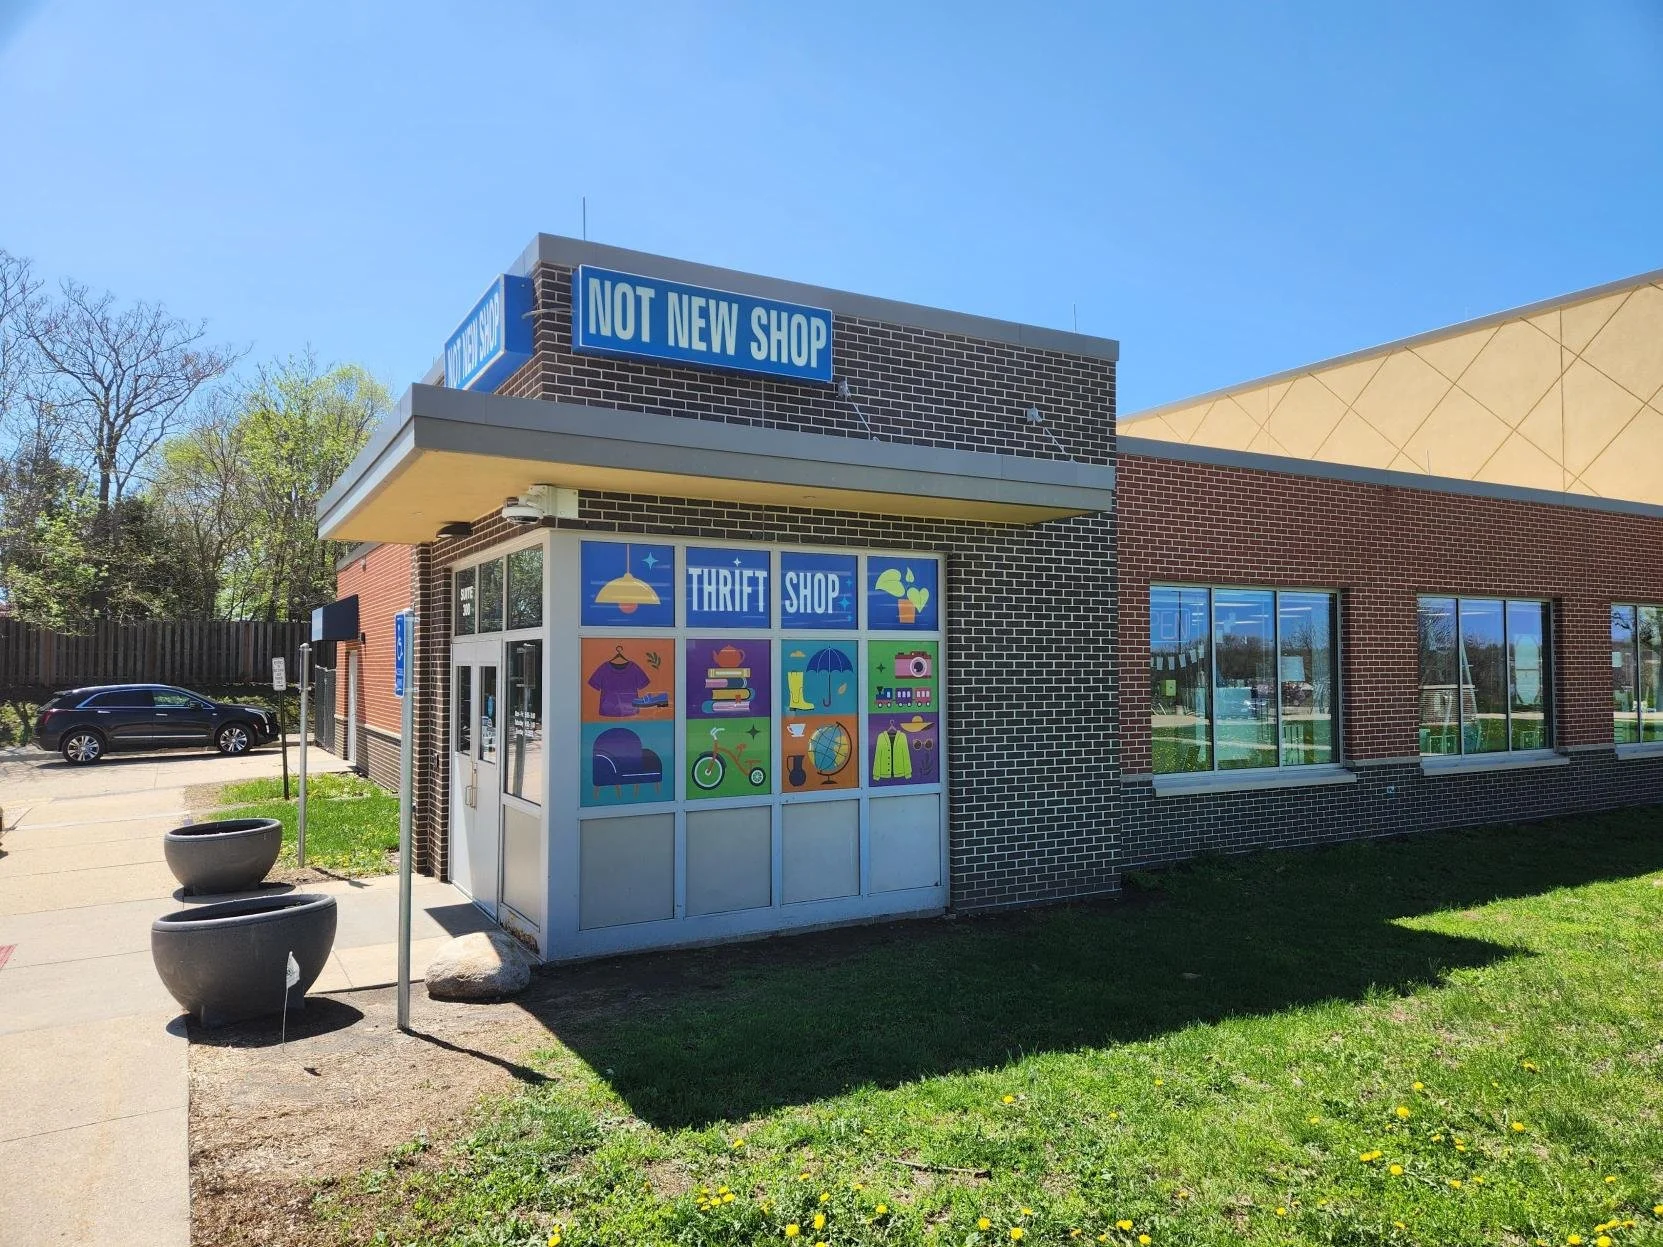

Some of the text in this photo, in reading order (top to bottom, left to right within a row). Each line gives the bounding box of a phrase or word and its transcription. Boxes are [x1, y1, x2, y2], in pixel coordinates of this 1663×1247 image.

[448, 291, 500, 389] NOT NEW SHOP
[588, 278, 827, 369] NOT NEW SHOP
[460, 585, 474, 602] SUITE
[462, 602, 471, 617] 300
[688, 567, 840, 614] THRIFT SHOP
[1150, 610, 1188, 641] PEN
